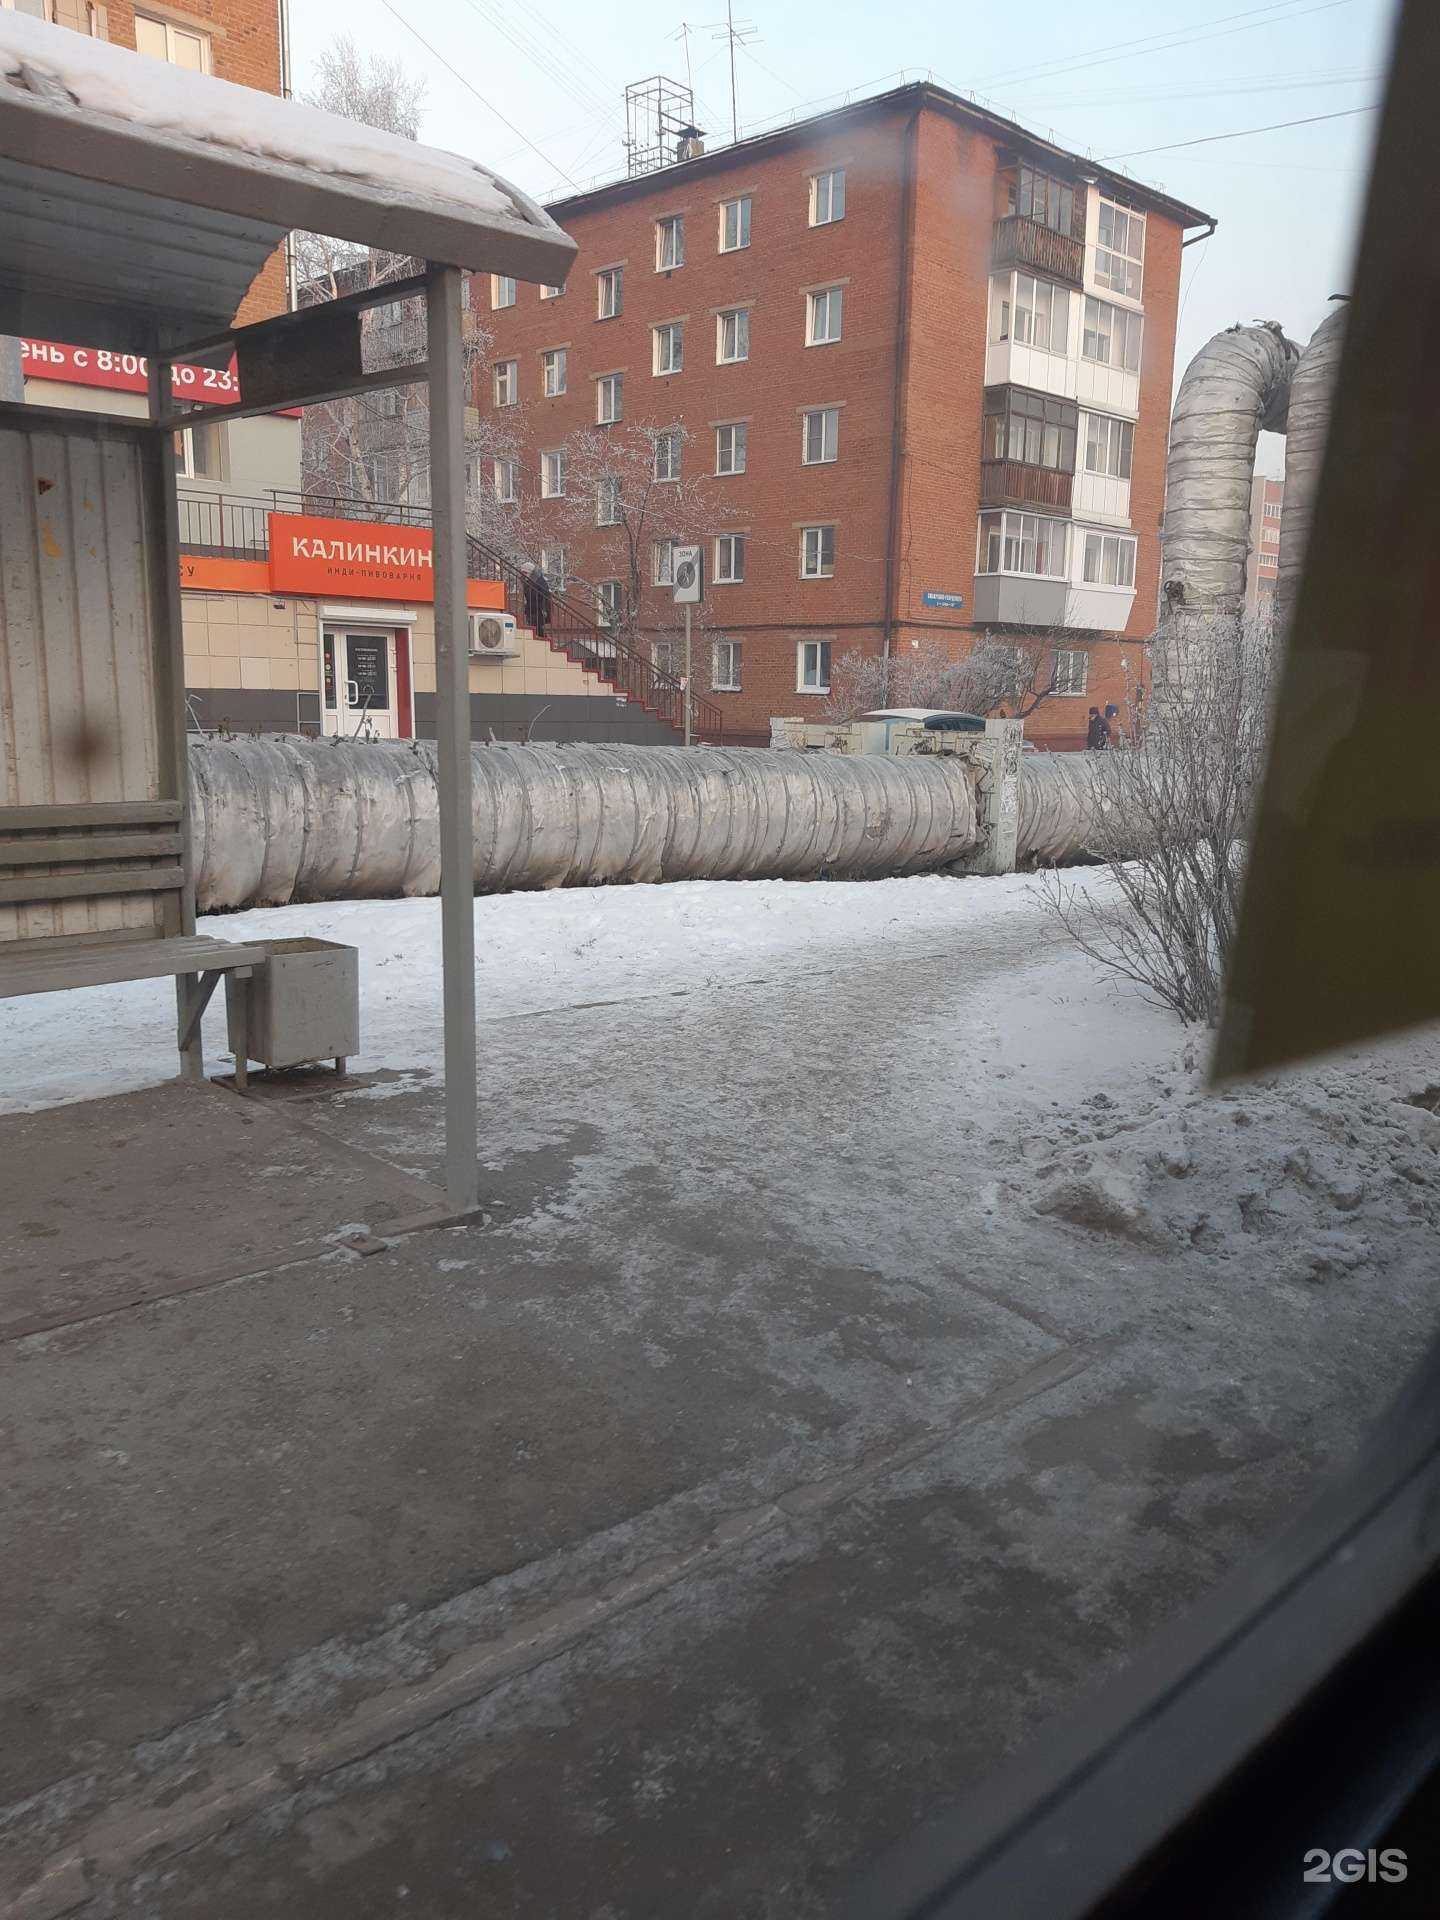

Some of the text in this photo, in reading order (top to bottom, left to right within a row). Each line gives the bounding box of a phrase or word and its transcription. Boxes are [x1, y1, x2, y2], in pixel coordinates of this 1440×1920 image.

[73, 350, 88, 367] с
[292, 536, 433, 567] КАЛИНКИН
[327, 567, 422, 581] ИНДИ-ПИВОВАРНЯ
